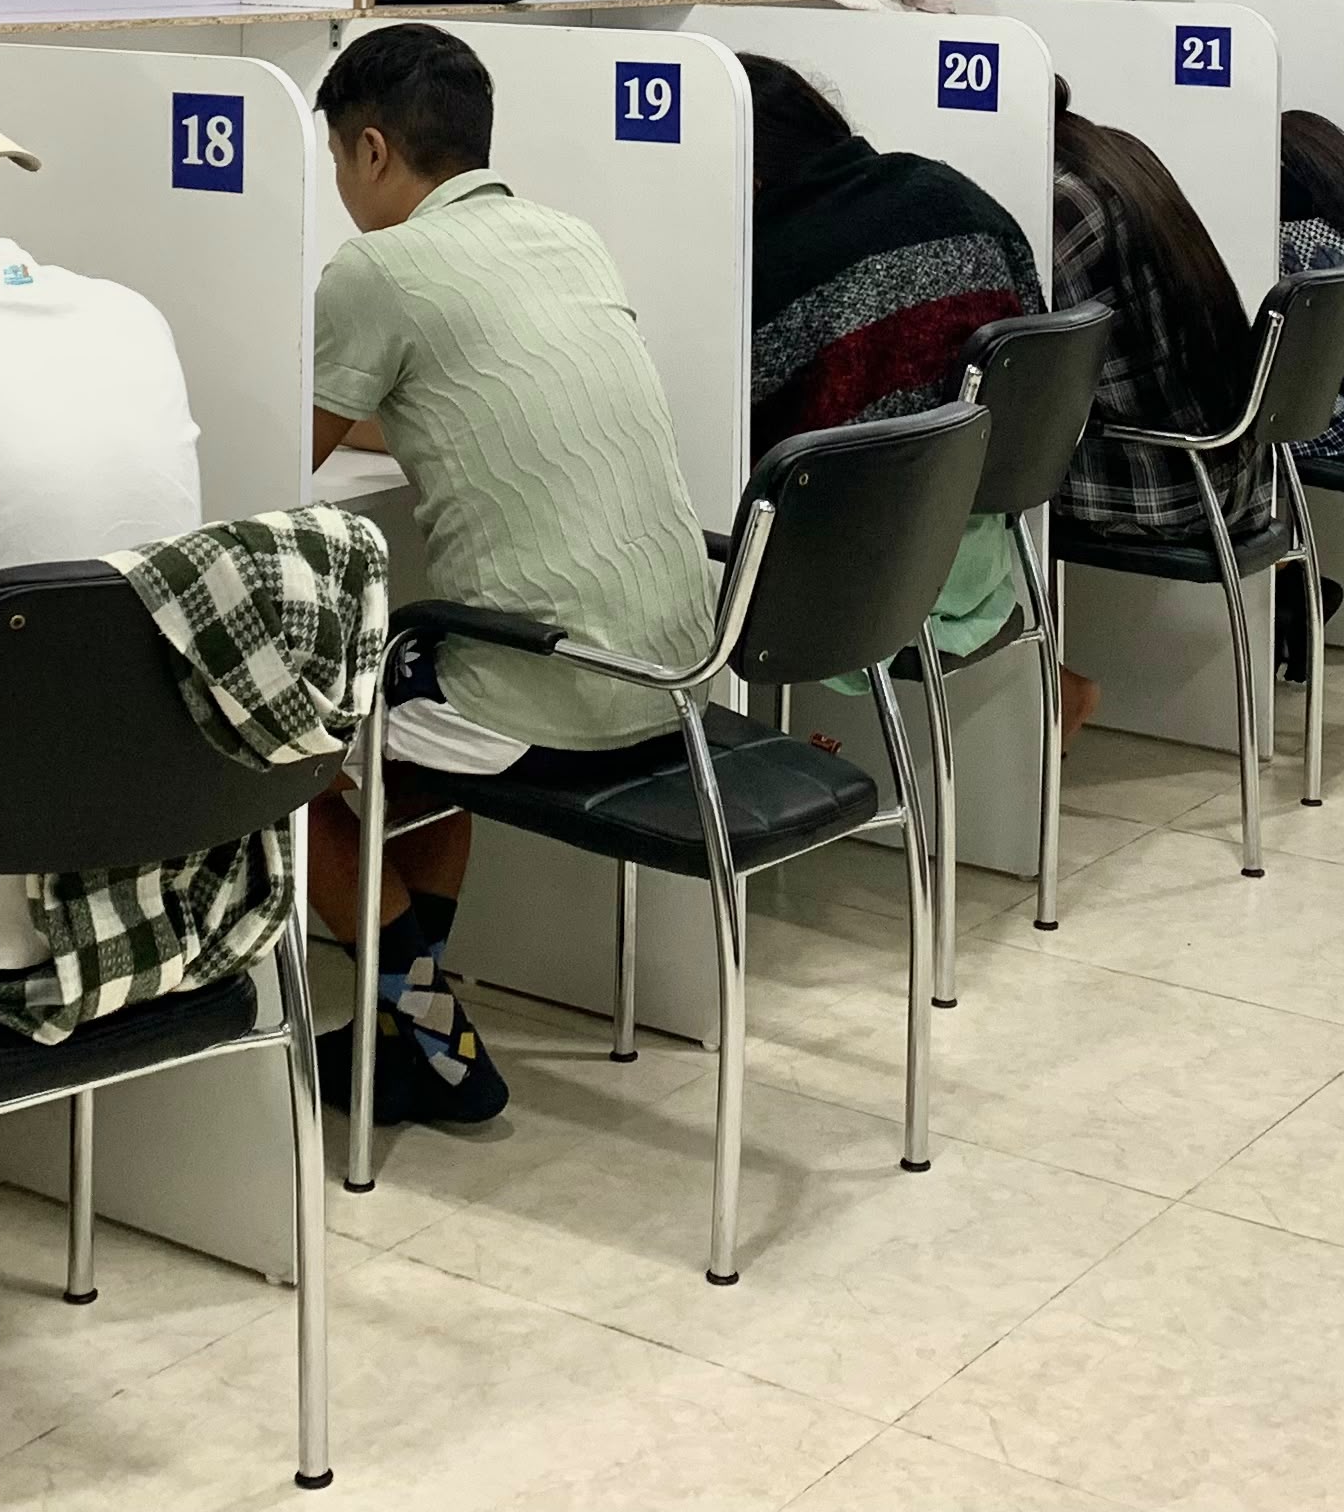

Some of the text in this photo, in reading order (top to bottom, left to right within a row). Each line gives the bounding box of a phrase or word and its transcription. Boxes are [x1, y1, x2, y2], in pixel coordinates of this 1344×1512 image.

[943, 52, 992, 92] 20
[1182, 36, 1224, 70] 21
[623, 76, 672, 121] 19
[181, 114, 235, 168] 18
